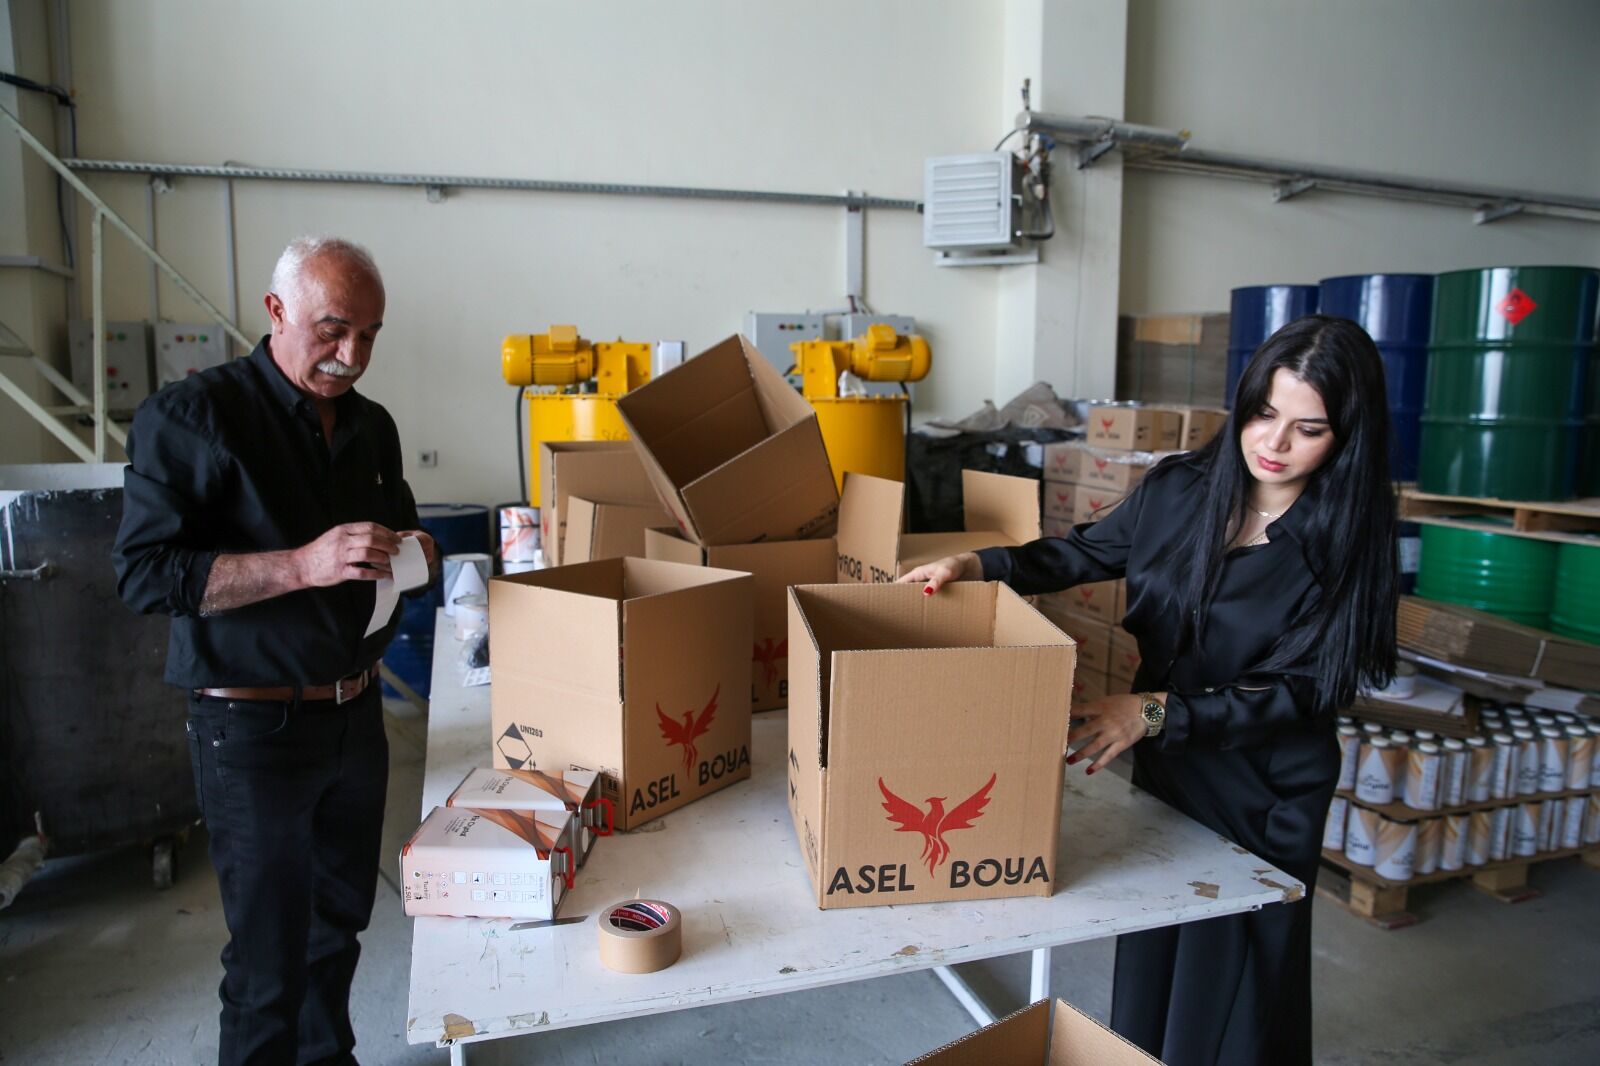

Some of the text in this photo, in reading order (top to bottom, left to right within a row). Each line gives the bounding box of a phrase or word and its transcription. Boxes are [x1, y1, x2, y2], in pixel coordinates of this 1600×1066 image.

[629, 744, 751, 816] ASEL BOYA
[827, 856, 1050, 895] ASEL BOYA
